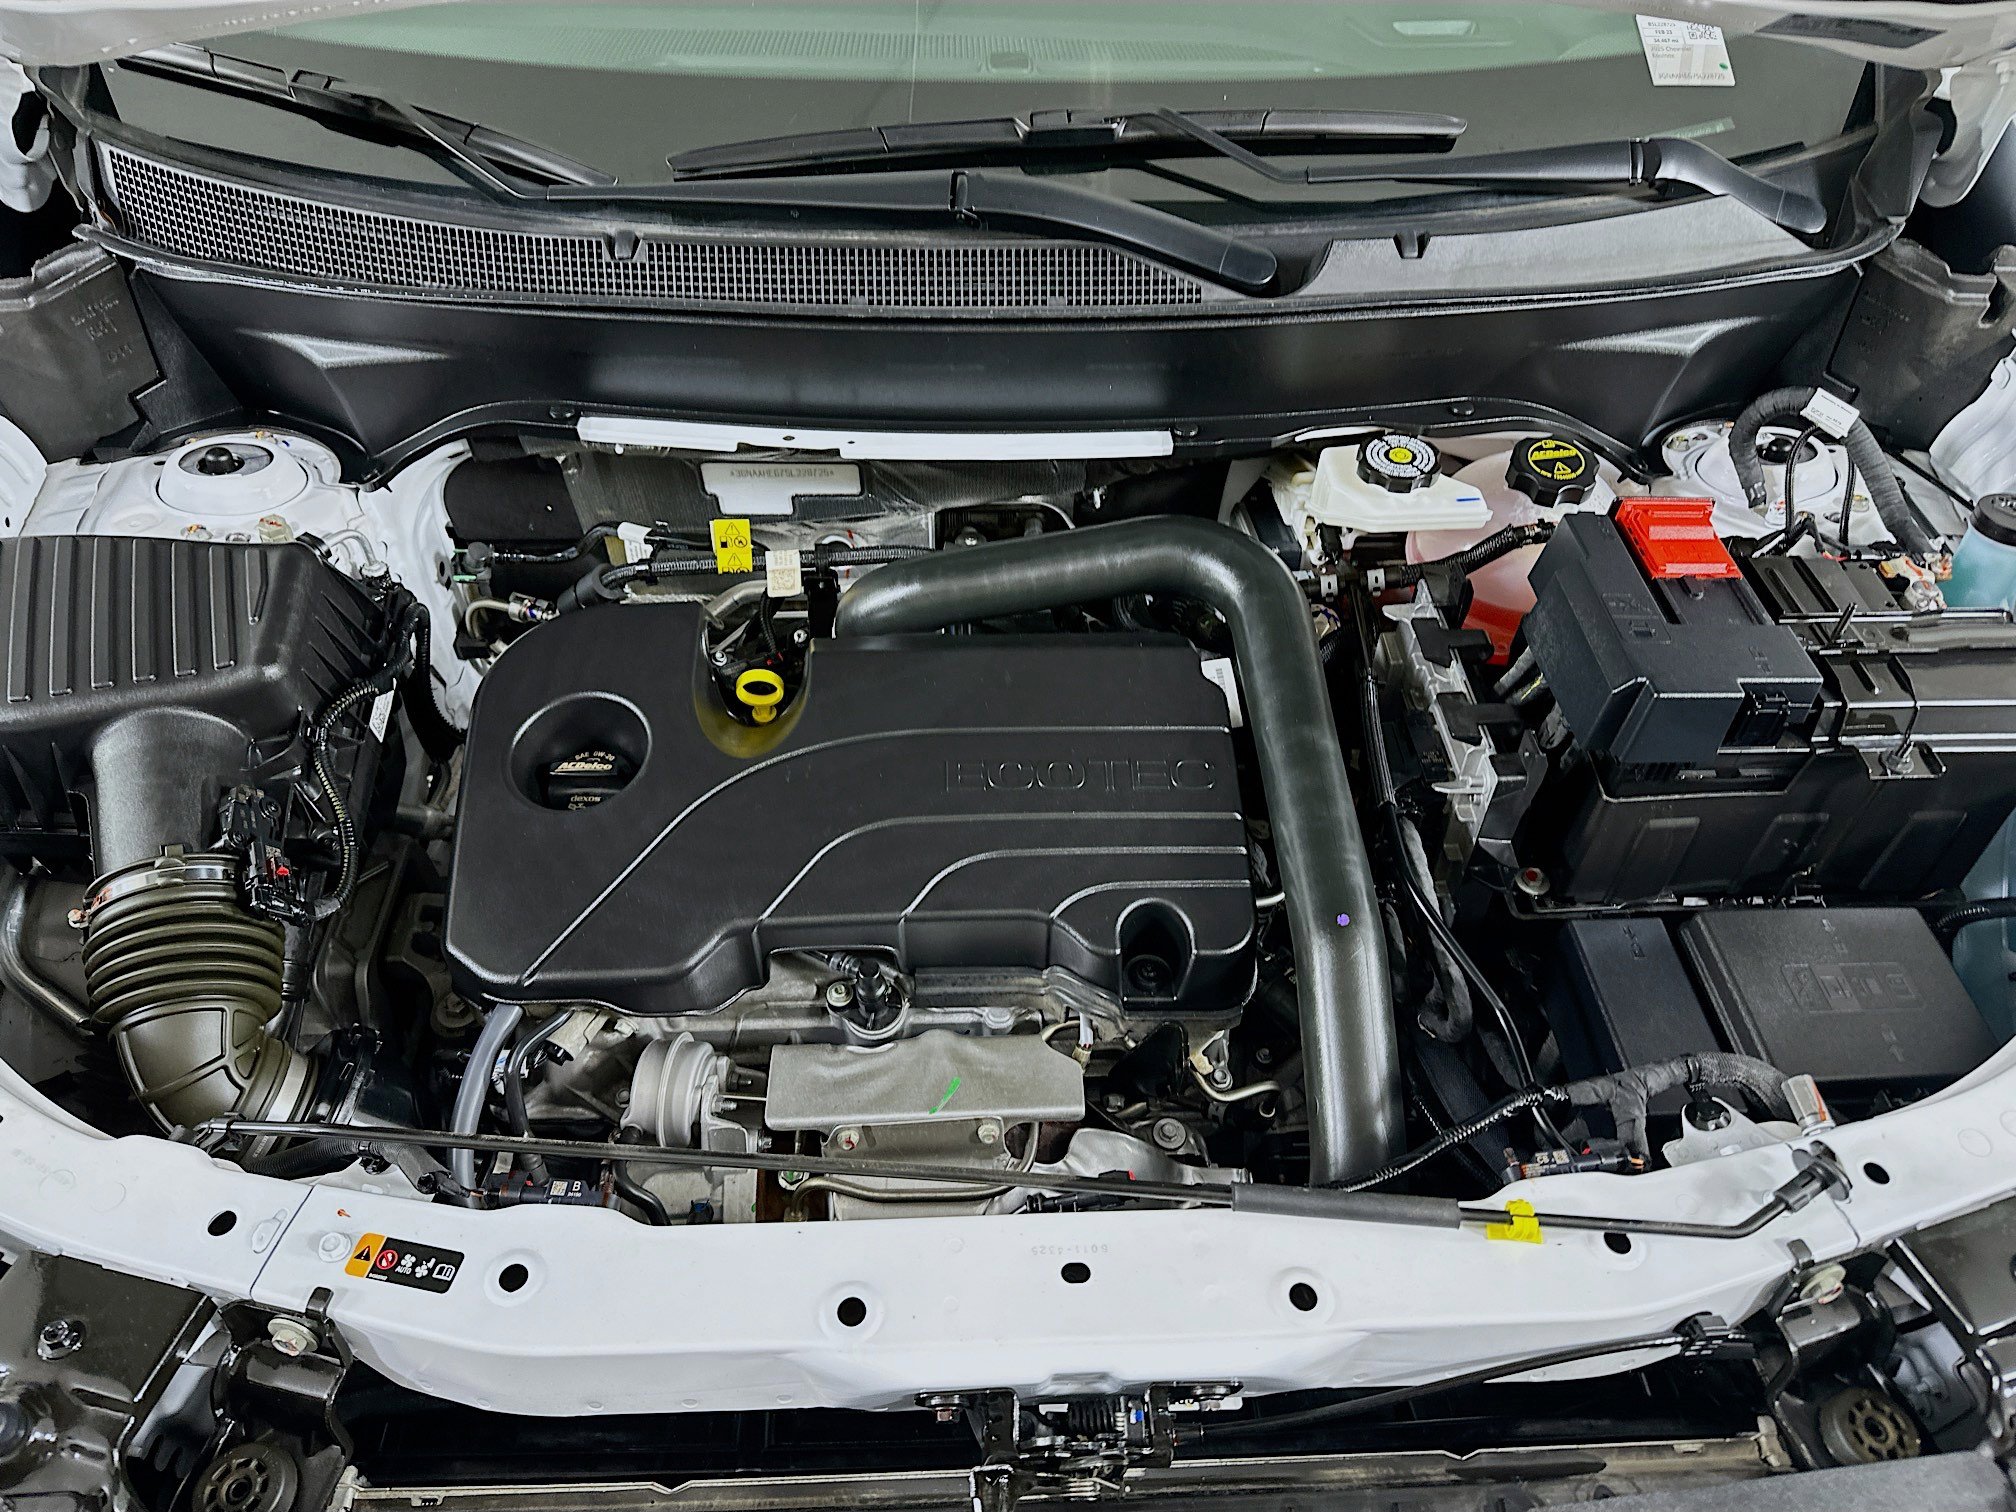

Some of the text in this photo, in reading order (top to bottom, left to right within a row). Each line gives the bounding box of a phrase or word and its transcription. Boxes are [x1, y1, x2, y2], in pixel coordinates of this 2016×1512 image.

[574, 751, 590, 761] SAE
[555, 761, 613, 772] ACDelco
[945, 760, 1216, 792] ECOTEC
[570, 794, 602, 803] dexos
[571, 1180, 582, 1192] B
[394, 1265, 413, 1275] AUTO
